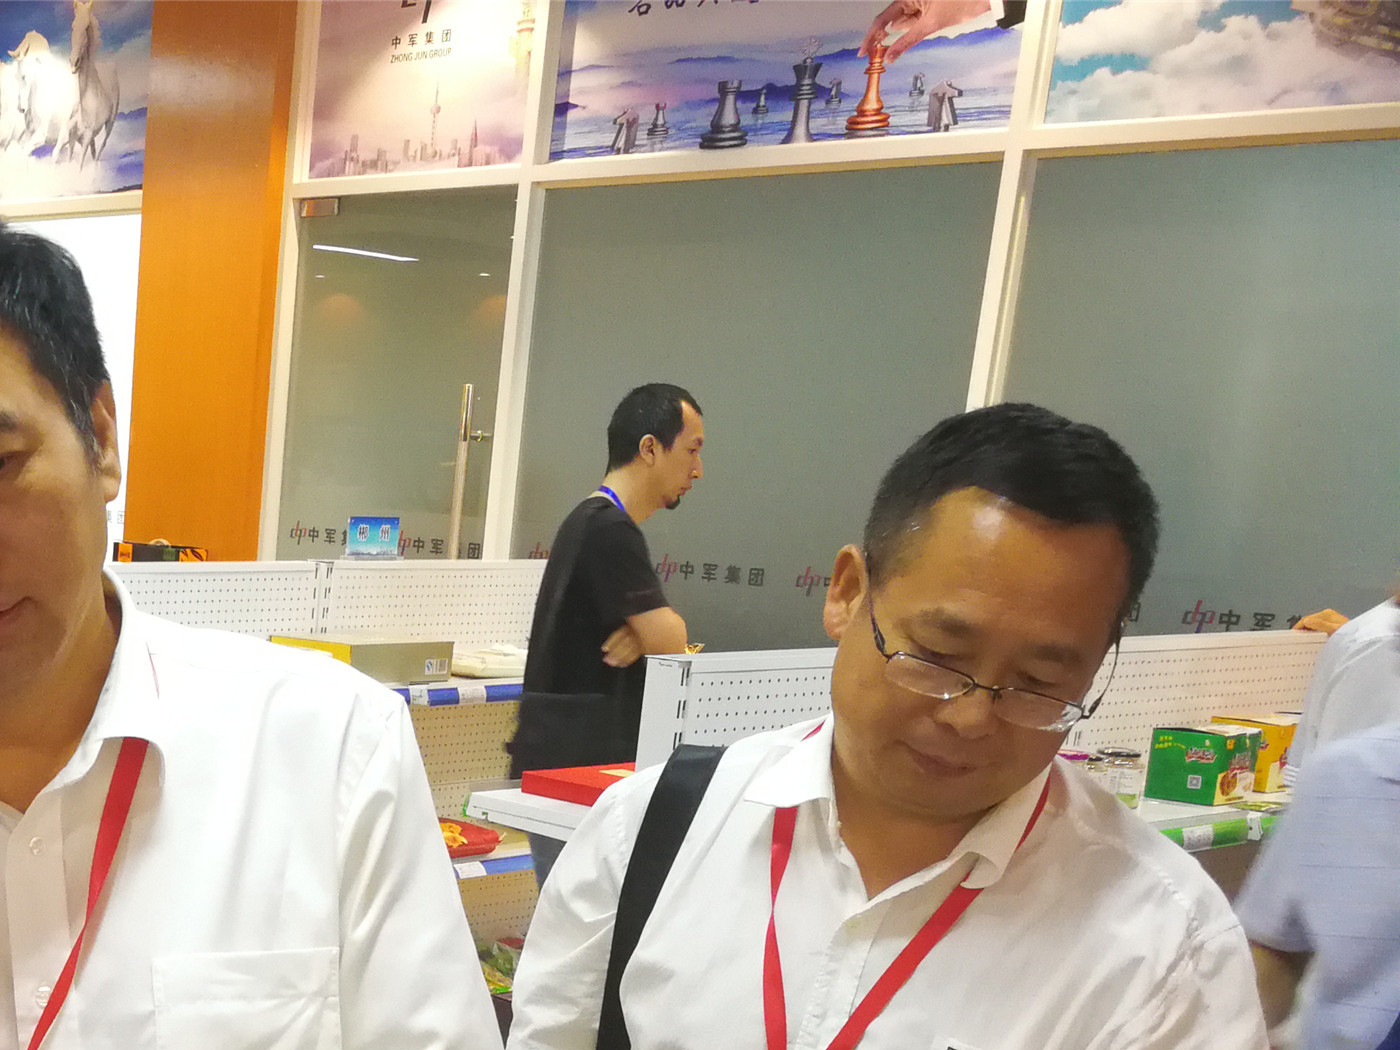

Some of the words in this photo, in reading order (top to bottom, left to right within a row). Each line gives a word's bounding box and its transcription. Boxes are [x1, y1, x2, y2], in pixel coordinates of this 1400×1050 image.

[391, 28, 452, 50] 中军集团
[390, 52, 413, 64] ZHONG
[414, 50, 428, 61] JUN
[429, 47, 452, 59] GROUP
[356, 523, 392, 542] 郴州
[412, 537, 482, 560] 中军团
[680, 560, 766, 588] 中军集团
